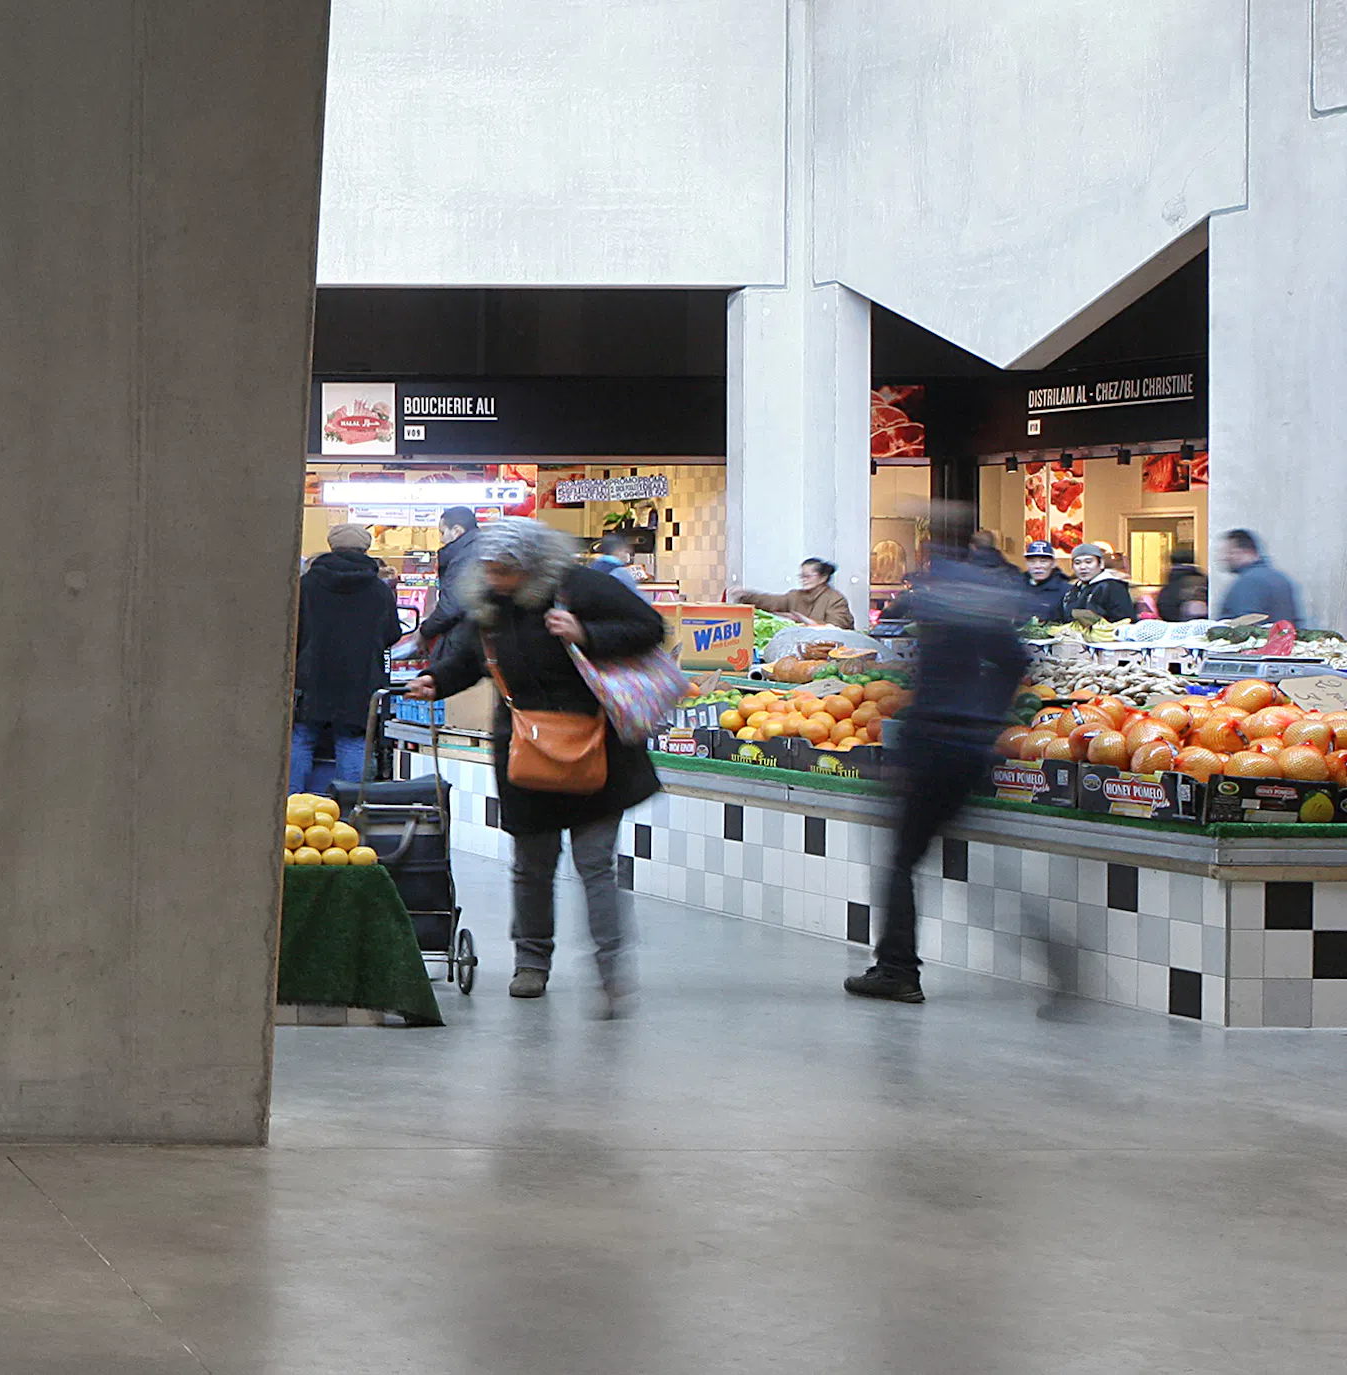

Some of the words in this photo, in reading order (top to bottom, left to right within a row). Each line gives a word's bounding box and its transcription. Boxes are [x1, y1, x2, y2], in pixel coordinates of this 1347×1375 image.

[1028, 386, 1075, 409] DISTRILAM
[1076, 385, 1087, 404] AL
[1095, 379, 1141, 402] CHEZ/BIJ
[1142, 374, 1194, 398] CHRISTINE
[404, 397, 474, 415] BOUCHERIE
[476, 397, 495, 415] ALI
[406, 428, 421, 437] V09
[694, 622, 741, 652] WABU
[994, 770, 1015, 783] HONEY
[1016, 773, 1044, 786] POMELO
[1106, 784, 1131, 796] HONEY
[1133, 786, 1162, 800] POMELO
